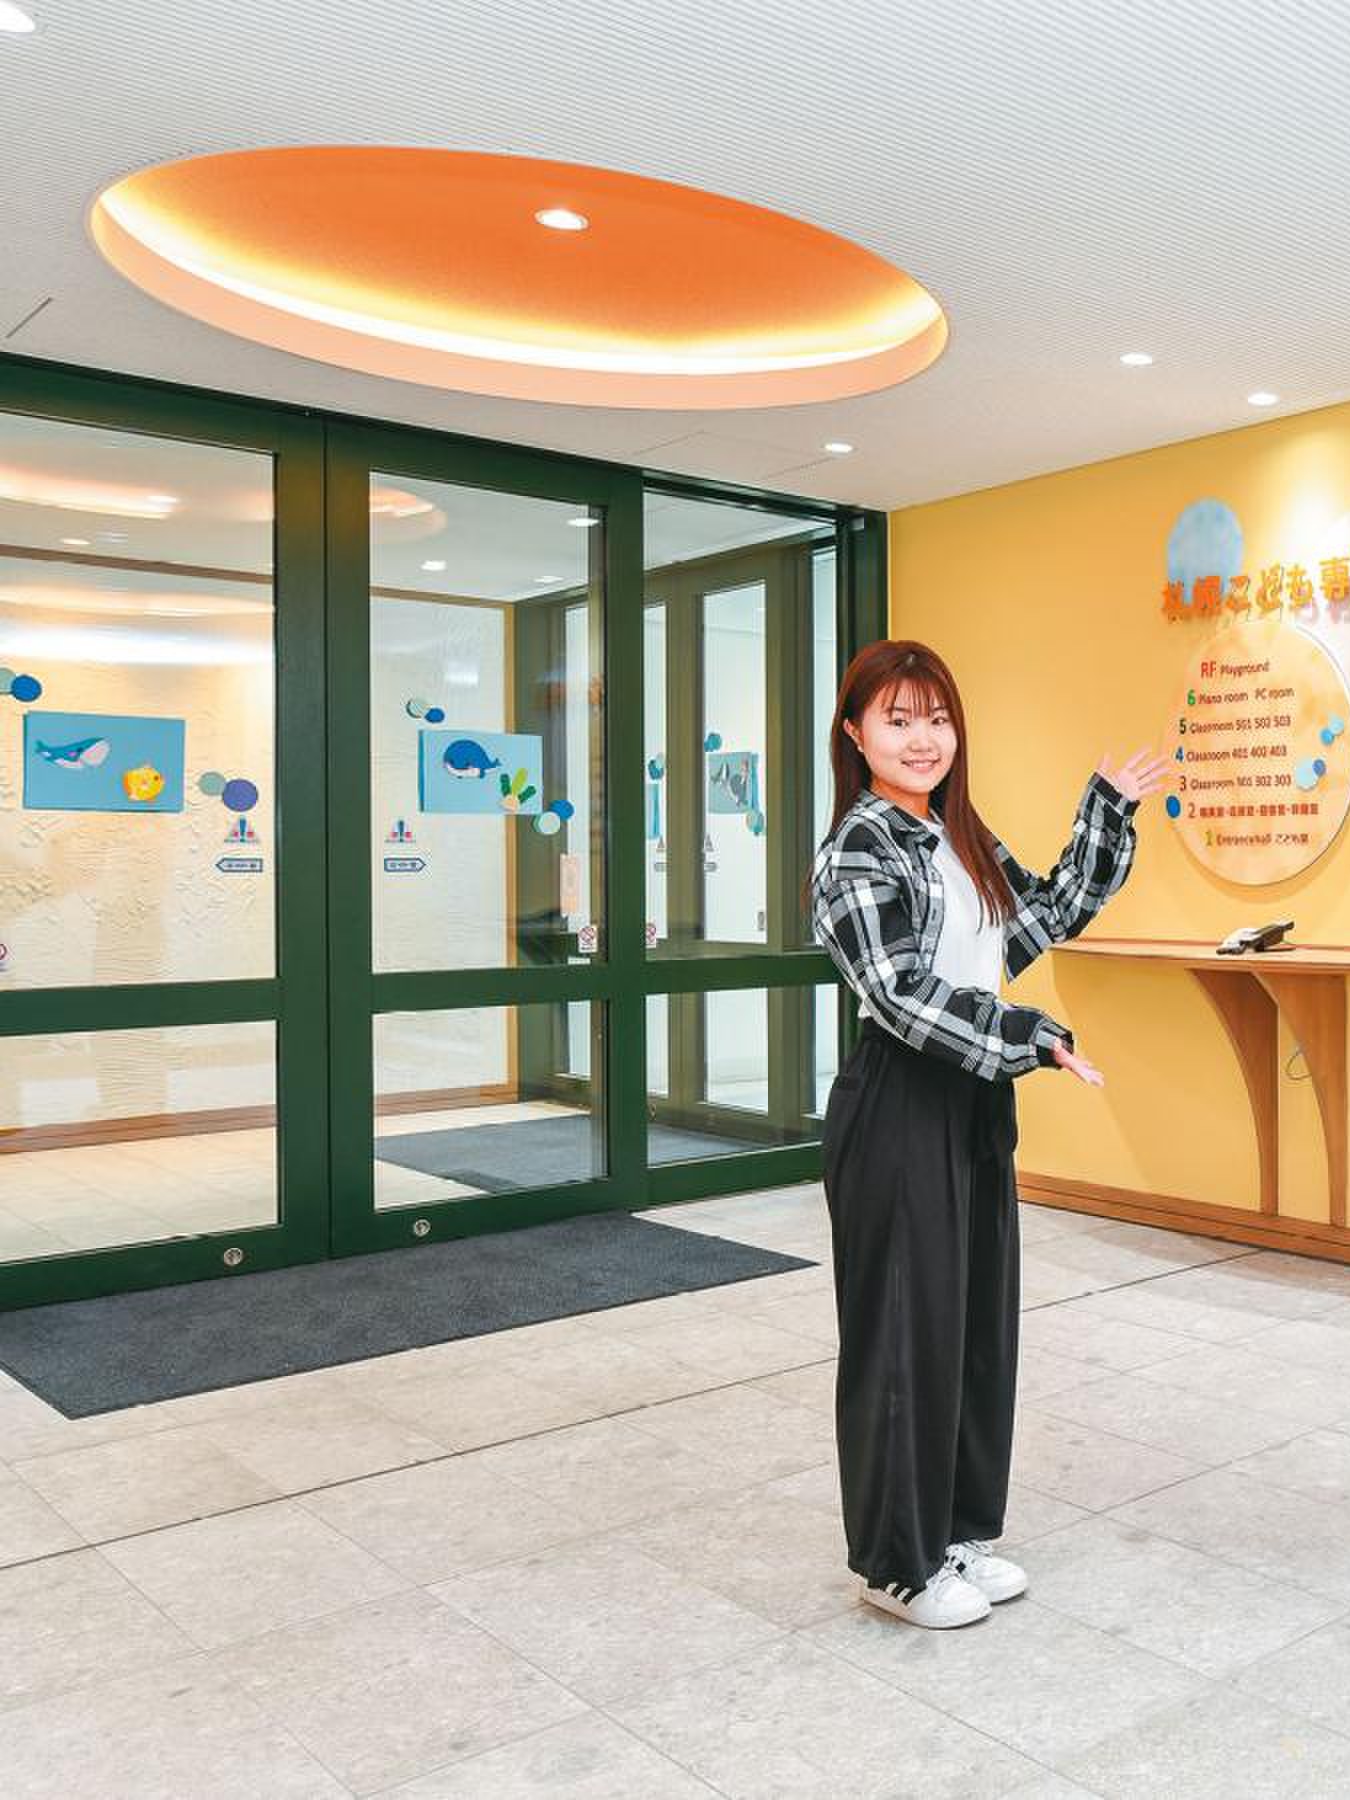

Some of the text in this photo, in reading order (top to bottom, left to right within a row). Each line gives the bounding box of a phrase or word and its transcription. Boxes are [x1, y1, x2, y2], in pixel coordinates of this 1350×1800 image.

[1201, 661, 1270, 678] RF Playground
[1187, 689, 1197, 706] 6
[1224, 691, 1249, 703] room
[1255, 688, 1268, 701] PC
[1269, 687, 1295, 699] room
[1179, 716, 1291, 735] 5 Classroom 501 502 503
[1175, 746, 1184, 762] 4
[1186, 750, 1231, 763] Classroom
[1179, 775, 1187, 792] 3
[1190, 779, 1234, 791] Classroom
[1187, 802, 1196, 819] 2
[1205, 830, 1213, 847] 1
